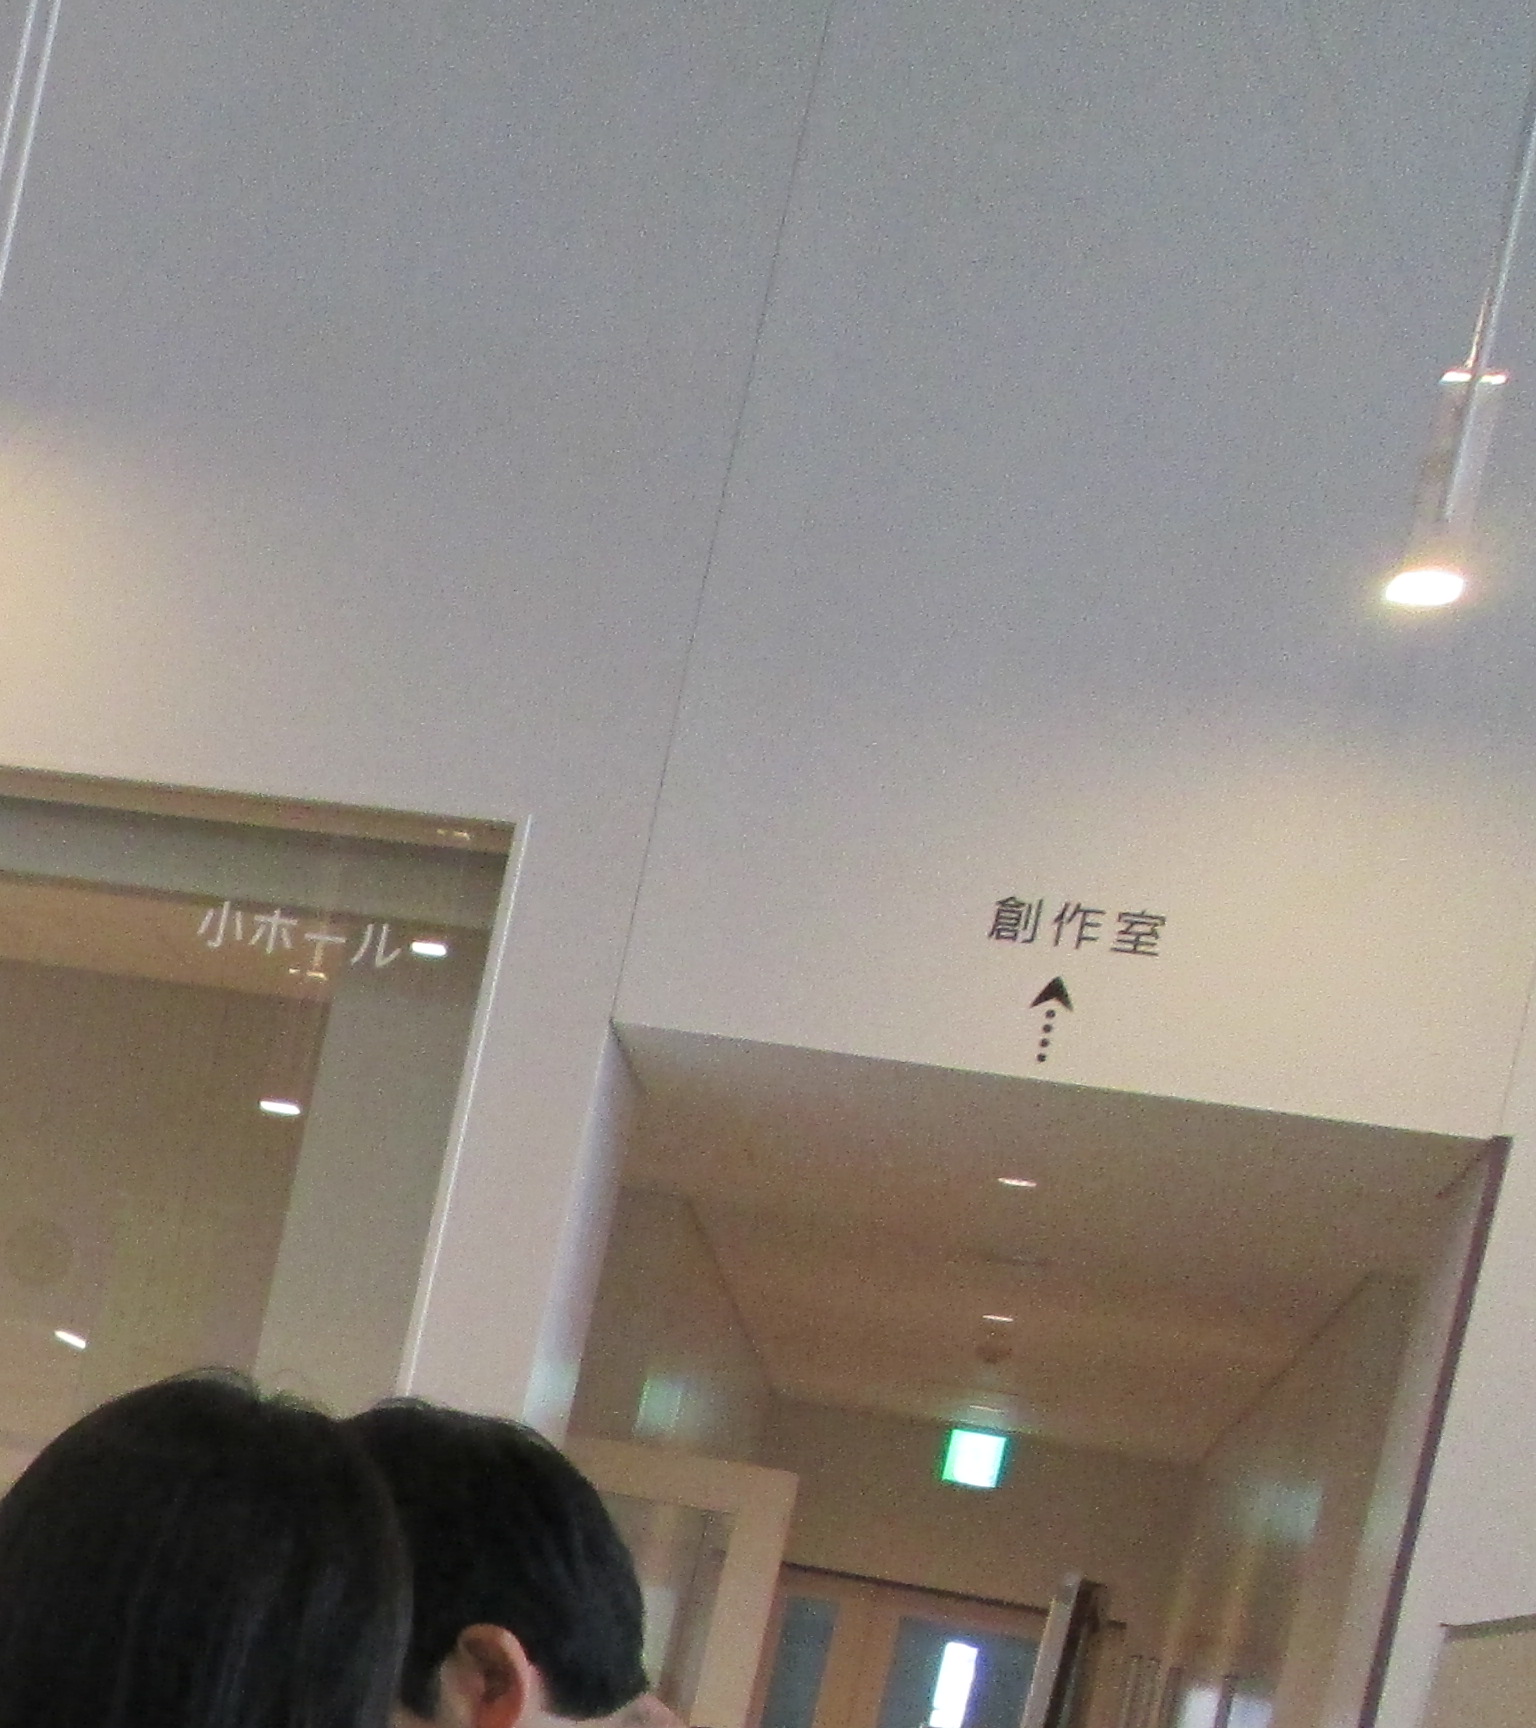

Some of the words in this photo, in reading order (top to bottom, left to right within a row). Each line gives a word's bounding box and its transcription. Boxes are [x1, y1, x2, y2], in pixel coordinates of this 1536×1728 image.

[196, 901, 402, 968] 小ホール
[987, 895, 1167, 957] 創作室
